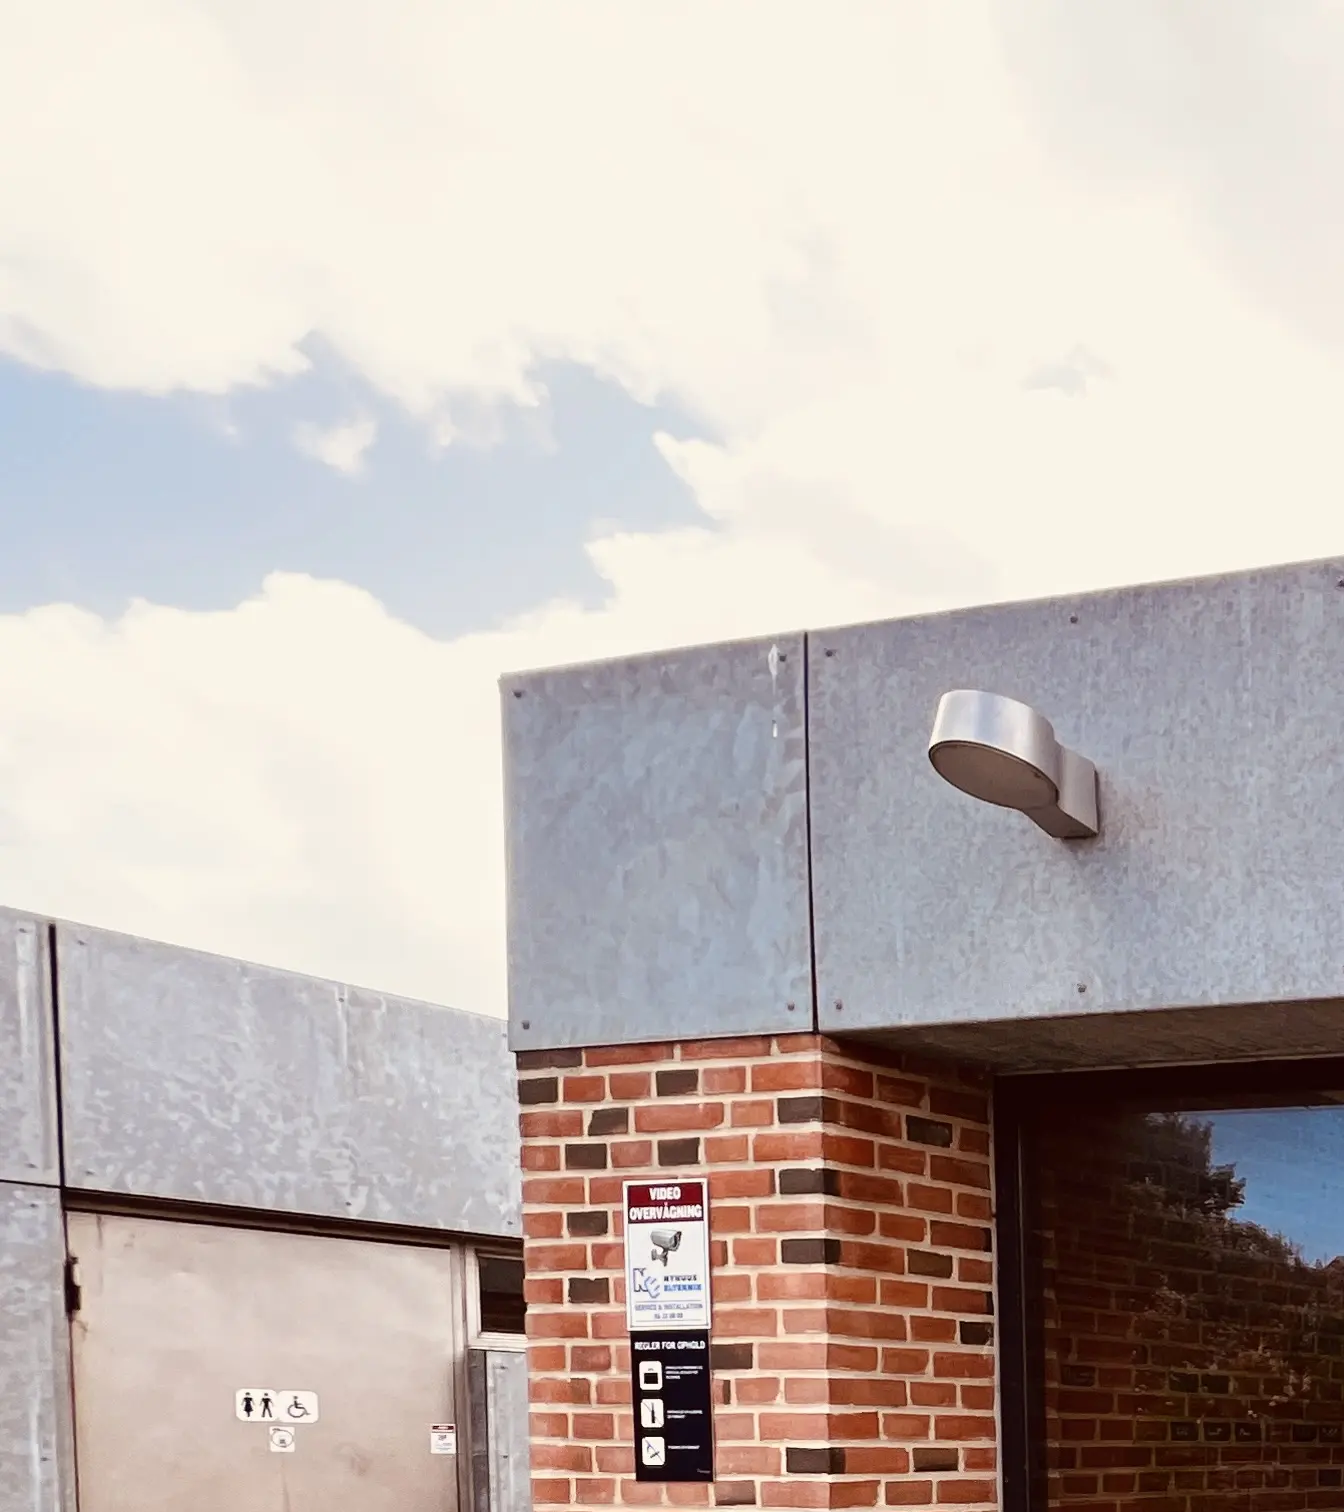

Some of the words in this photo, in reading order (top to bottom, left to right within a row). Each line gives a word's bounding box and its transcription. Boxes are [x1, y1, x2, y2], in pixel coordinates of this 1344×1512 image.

[649, 1186, 681, 1200] VIDEO
[629, 1201, 702, 1220] OVERVÅGNING
[661, 1341, 676, 1350] FOR
